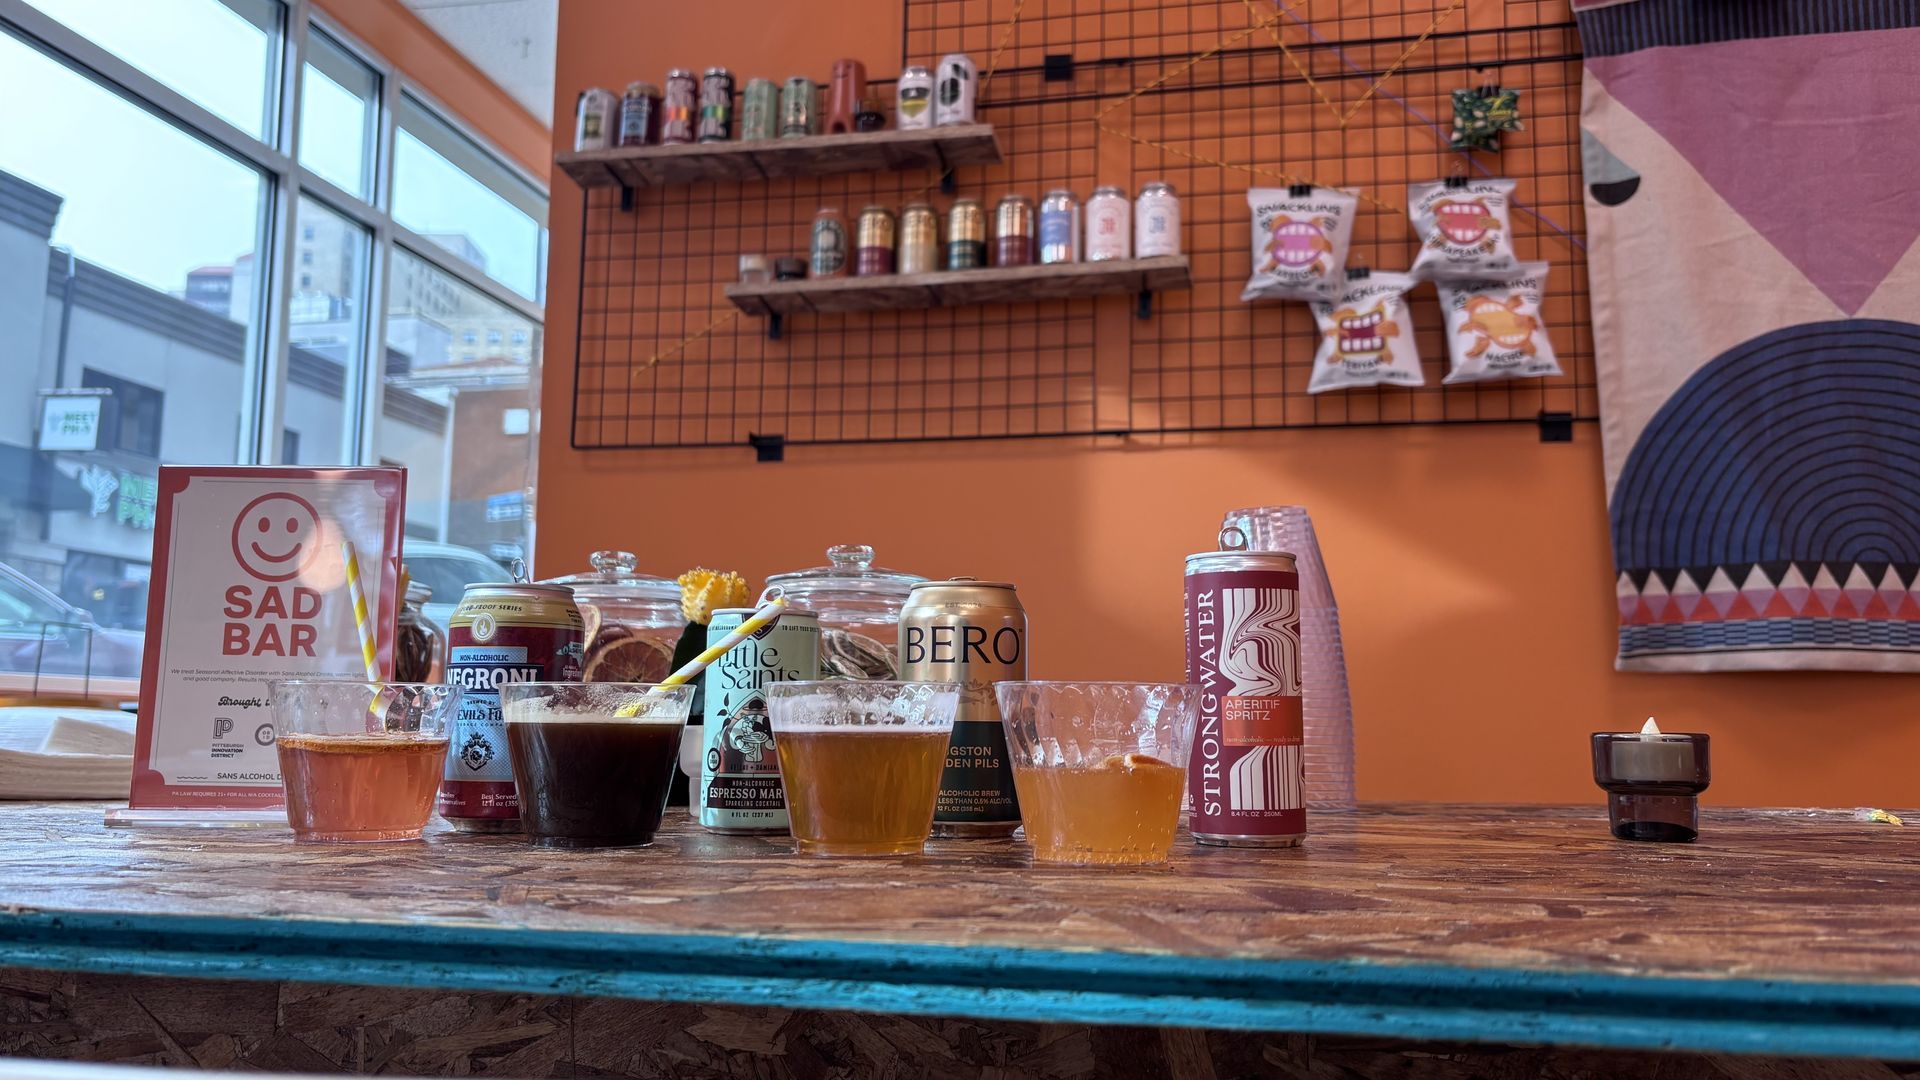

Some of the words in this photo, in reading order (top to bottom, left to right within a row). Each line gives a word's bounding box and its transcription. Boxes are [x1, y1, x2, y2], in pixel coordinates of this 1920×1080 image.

[223, 585, 322, 620] SAD
[221, 622, 318, 657] BAR
[906, 625, 1021, 666] BERO
[459, 654, 510, 662] NON-ALCOHOLIC
[447, 667, 538, 690] NEGRONI
[721, 663, 800, 690] Saints
[217, 695, 262, 710] Brought
[1197, 588, 1222, 817] STRONGWATER
[1225, 699, 1281, 710] APERITIF
[457, 709, 486, 721] EVIL'S
[487, 707, 503, 721] FO
[1225, 710, 1271, 721] SPRITZ
[949, 746, 992, 756] GSTON
[945, 758, 971, 768] DEN
[974, 758, 999, 768] PILS
[217, 772, 238, 780] SANS
[239, 773, 274, 781] ALCOHOL
[495, 793, 517, 801] Served
[709, 787, 757, 799] ESPRESSO
[759, 788, 783, 800] MAR
